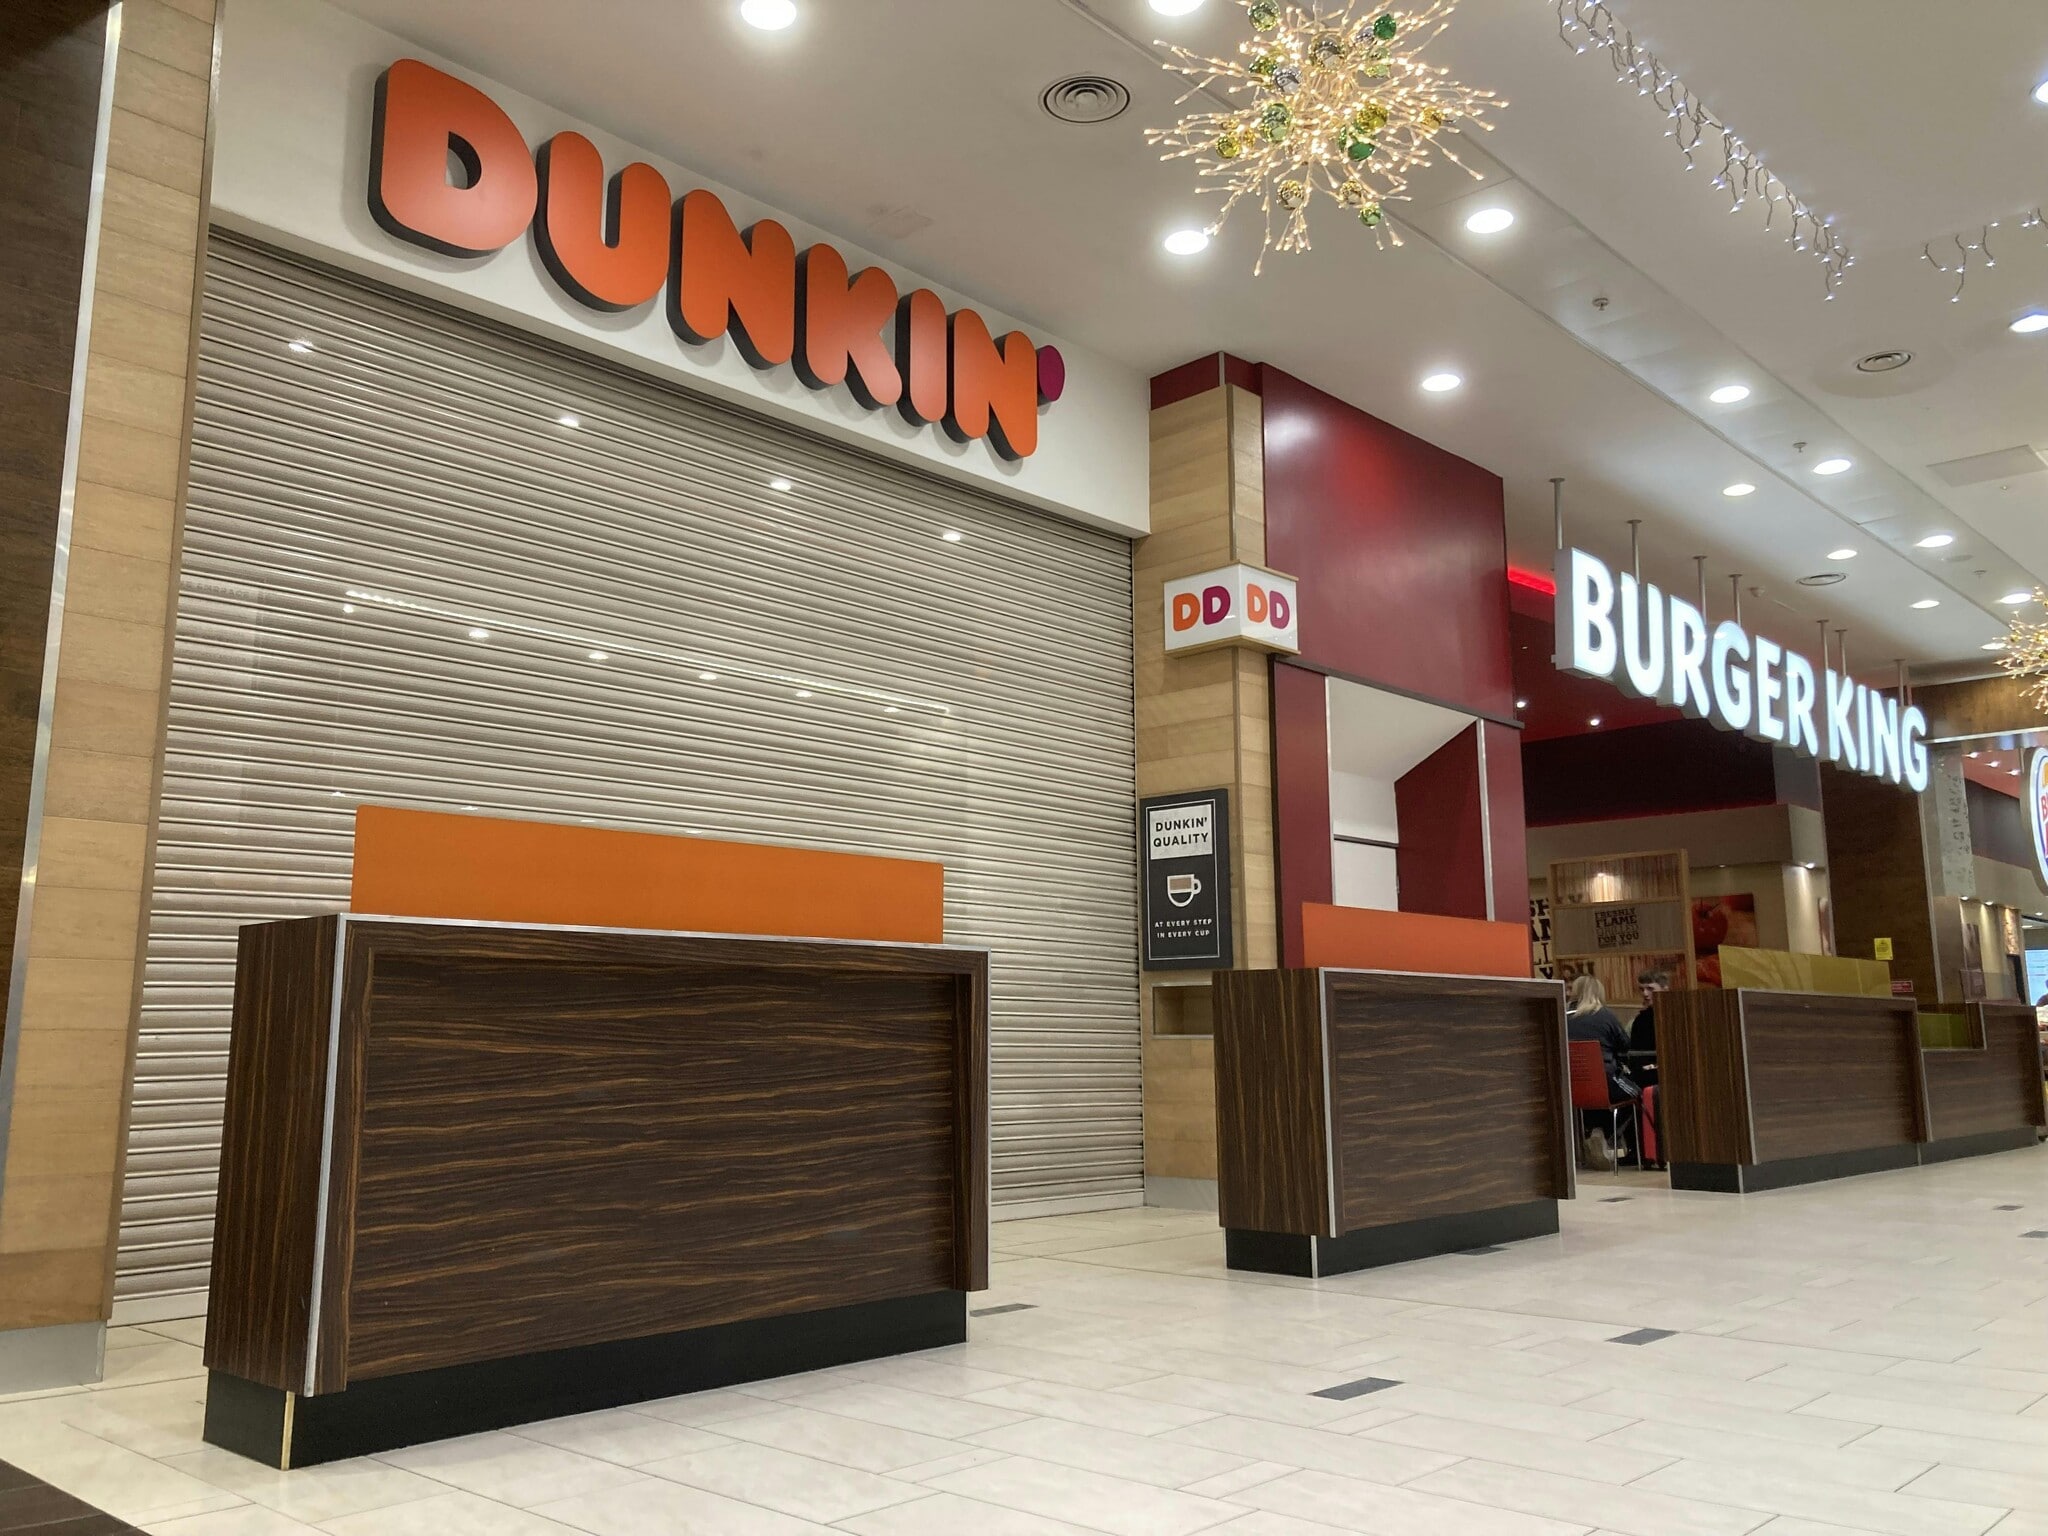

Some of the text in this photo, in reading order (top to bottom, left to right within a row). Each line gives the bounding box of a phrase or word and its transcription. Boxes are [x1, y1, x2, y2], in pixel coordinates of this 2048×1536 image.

[370, 58, 1066, 459] DUNKIN'
[1172, 585, 1231, 632] DD
[1246, 583, 1290, 630] DD
[1571, 547, 1928, 792] BURGER KING
[1155, 817, 1208, 832] DUNKIN'
[1153, 832, 1209, 848] QUALITY
[1193, 918, 1212, 926] STEP
[1596, 914, 1638, 928] FLAME
[1619, 932, 1639, 942] YOU
